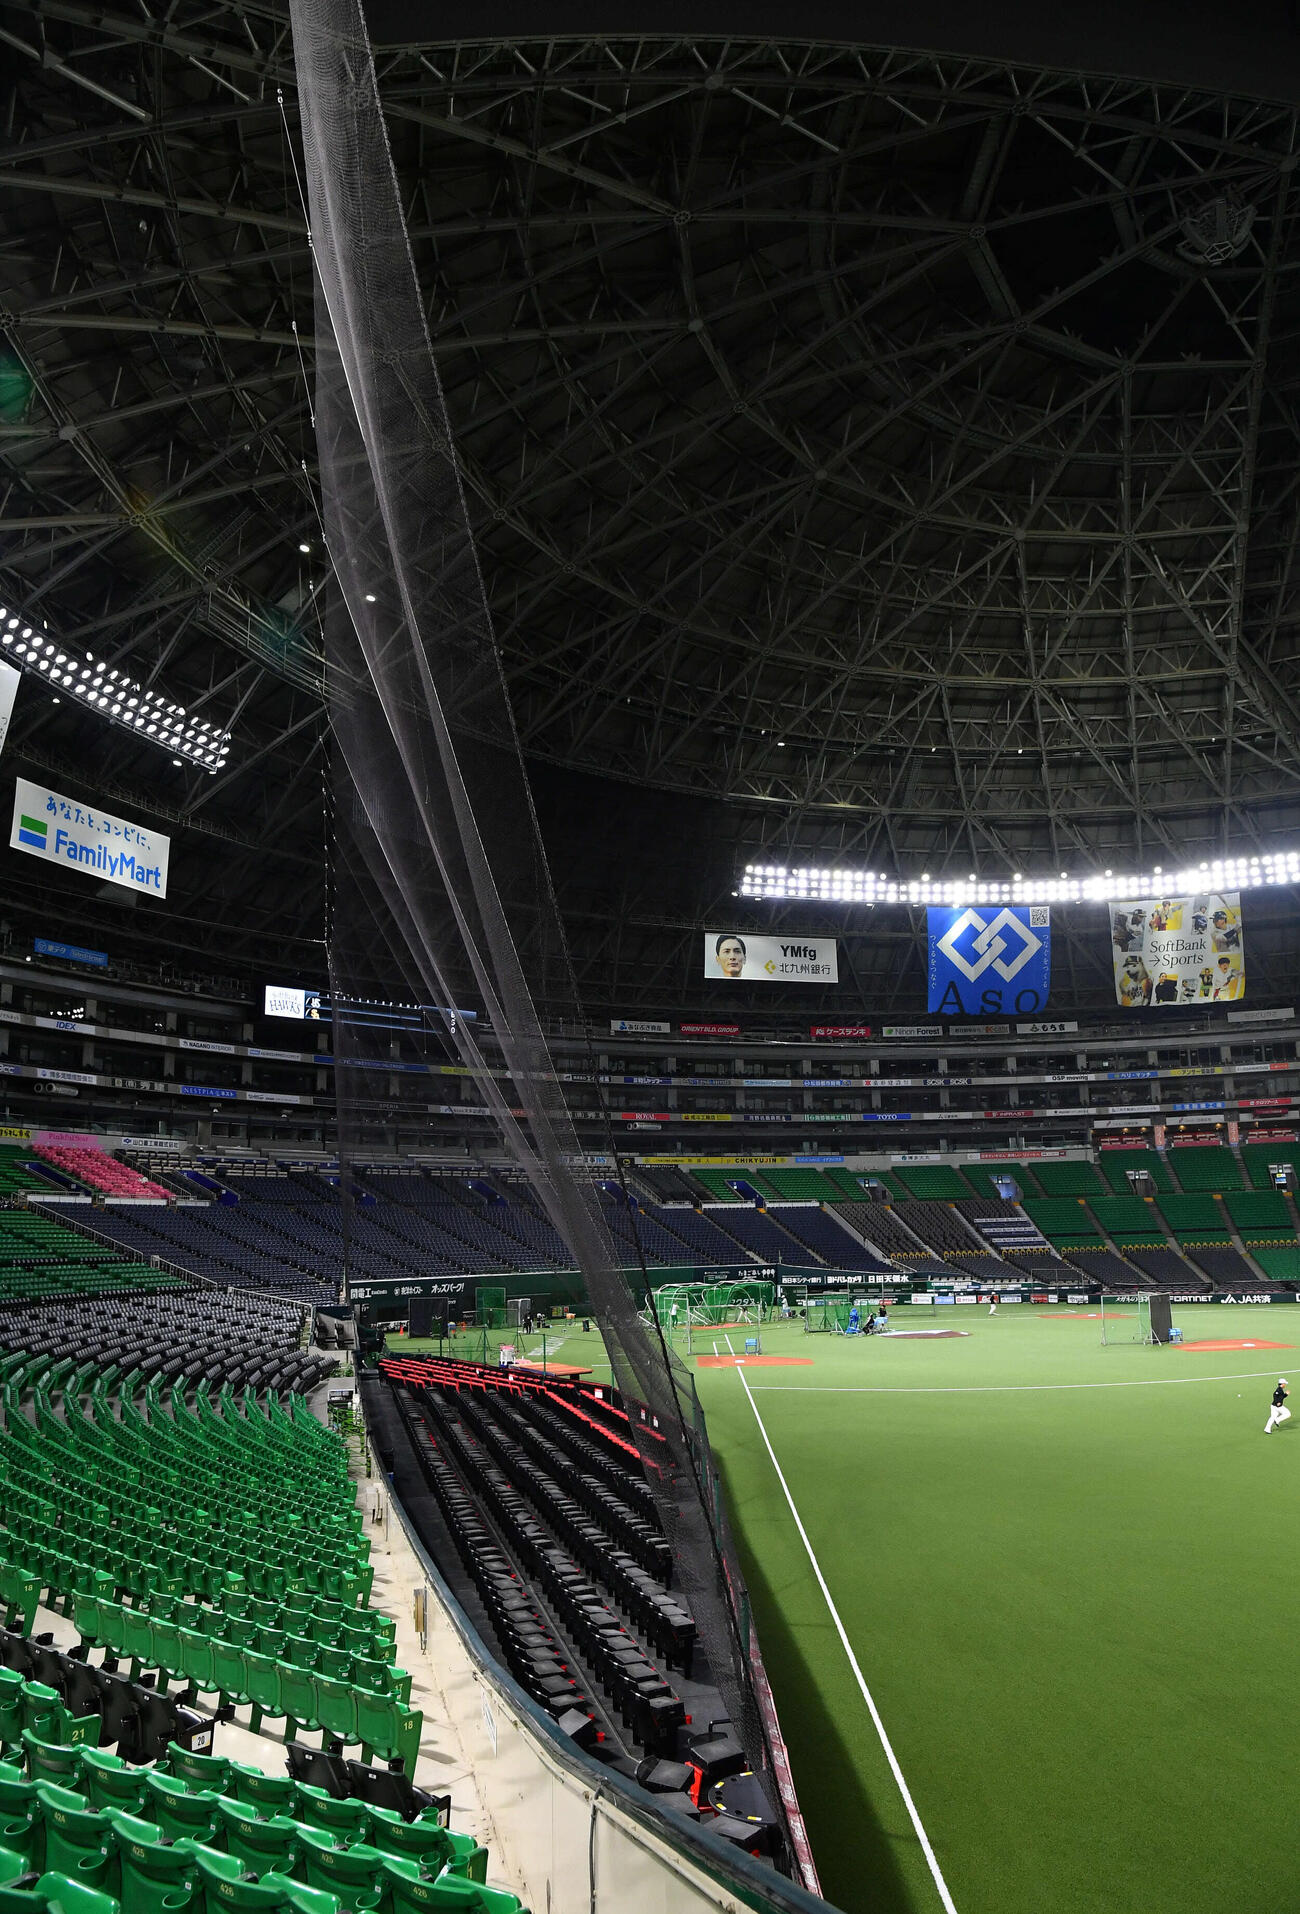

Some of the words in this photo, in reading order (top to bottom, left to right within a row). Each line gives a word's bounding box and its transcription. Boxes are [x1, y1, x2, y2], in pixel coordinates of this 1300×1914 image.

[46, 795, 152, 850] あなたと、コンビに、
[55, 829, 161, 889] FamilyMart
[1150, 938, 1206, 954] SoftBank
[780, 945, 817, 961] YMfg
[1161, 954, 1204, 968] Sports
[779, 963, 831, 975] 北九州銀行
[56, 1021, 77, 1031] IDEX
[916, 1028, 940, 1036] Forest
[188, 1042, 211, 1050] NAGANO
[782, 1276, 822, 1284] 西日本シティ銀行
[827, 1275, 862, 1284] ヨドバシカメラ
[1238, 1295, 1272, 1304] JA共済
[24, 1584, 33, 1592] 18
[404, 1720, 414, 1731] 18
[72, 1727, 85, 1742] 21
[197, 1735, 206, 1746] 20
